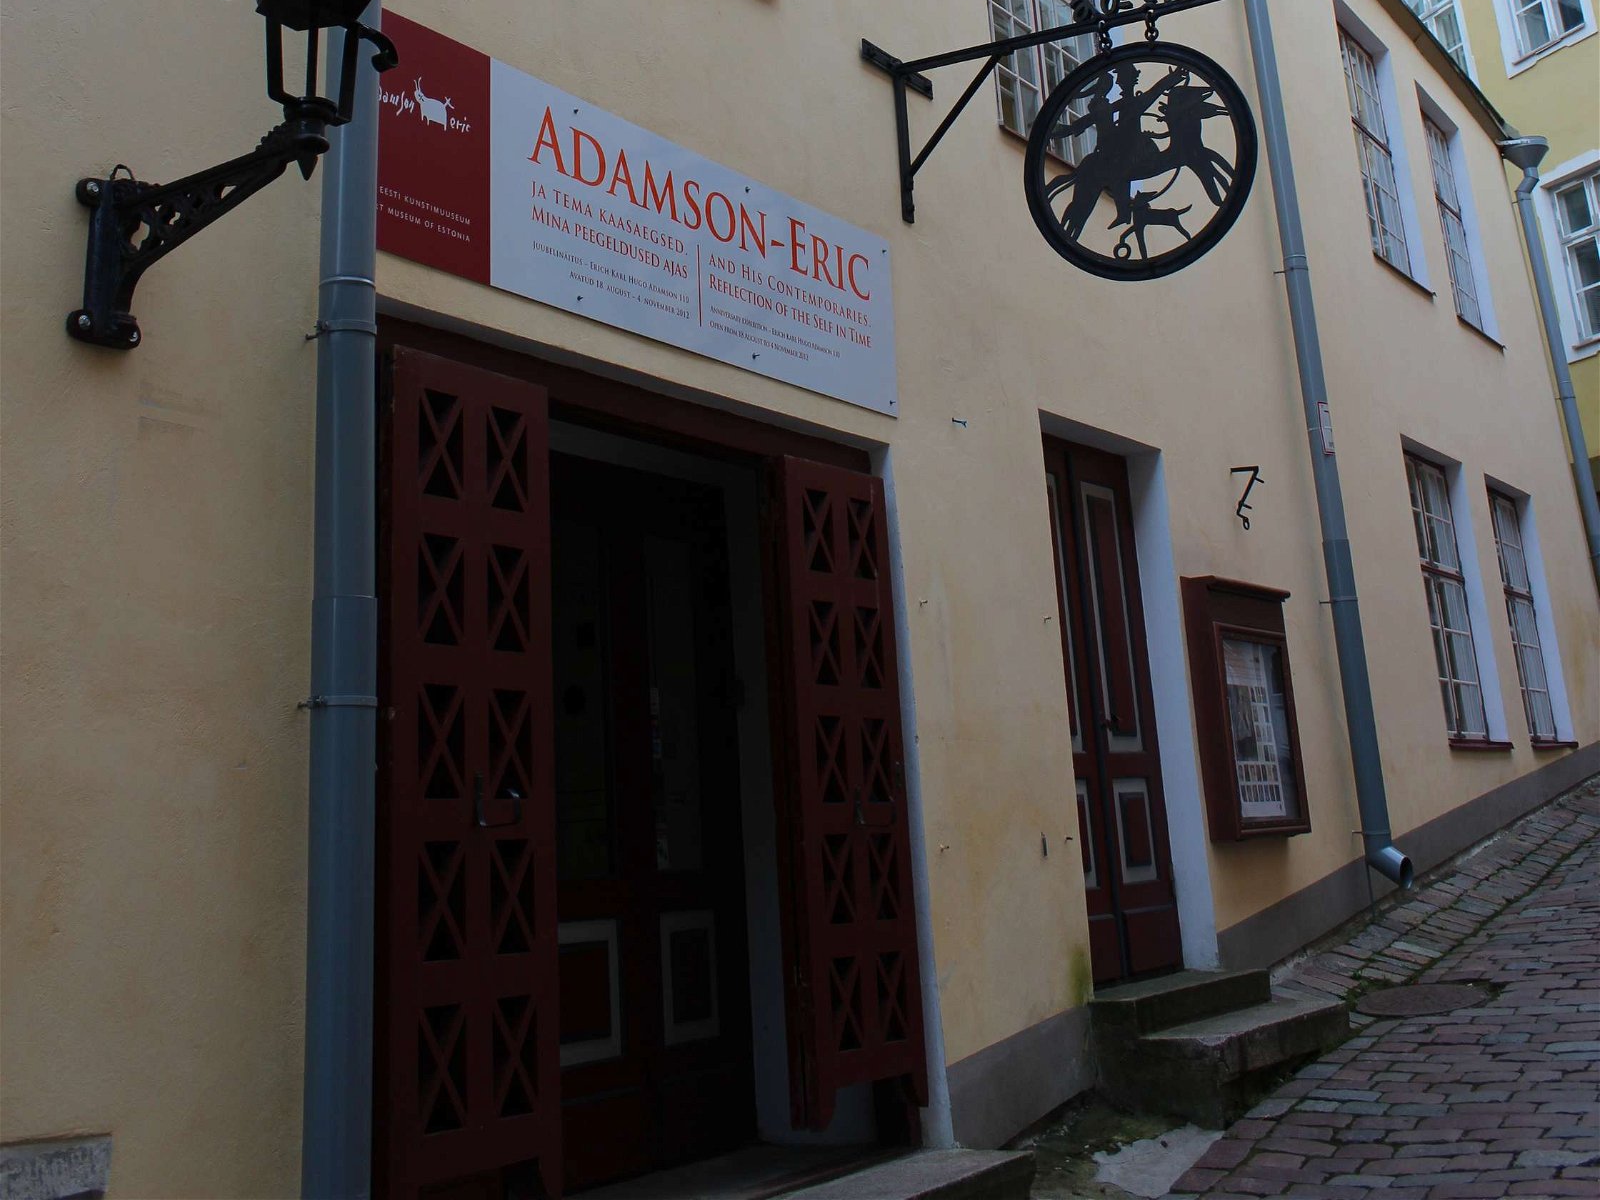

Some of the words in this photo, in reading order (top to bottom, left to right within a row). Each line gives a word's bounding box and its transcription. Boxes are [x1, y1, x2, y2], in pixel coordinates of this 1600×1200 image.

[450, 116, 471, 133] eric
[379, 185, 401, 200] EESTI
[404, 195, 470, 225] KUNSTIMUUSEUM
[388, 208, 421, 224] MUSEUM
[424, 220, 434, 229] OF
[438, 224, 470, 242] ESTONIA
[526, 105, 871, 302] ADAMSON-ERIC
[531, 180, 546, 200] JA
[553, 189, 593, 217] TEMA
[599, 208, 688, 256] KAASAEGSED.
[532, 205, 570, 234] MINA
[574, 223, 660, 268] PEEGELDUSED
[663, 259, 688, 278] AJAS
[570, 271, 594, 286] AVATUD
[607, 285, 630, 299] AUGUST
[644, 298, 675, 314] NOVEMBER
[677, 308, 689, 319] 2012
[590, 261, 609, 275] ERICH
[611, 269, 627, 281] KARL
[628, 276, 648, 288] HUGO
[649, 283, 677, 300] ADAMSON
[709, 254, 735, 274] AND
[741, 264, 763, 286] HIS
[768, 275, 871, 328] CONTEMPORARIES.
[709, 273, 772, 310] REFLECTION
[775, 301, 788, 317] OF
[791, 307, 810, 326] THE
[814, 314, 833, 334] SELF
[836, 324, 847, 338] IN
[848, 328, 872, 348] TIME
